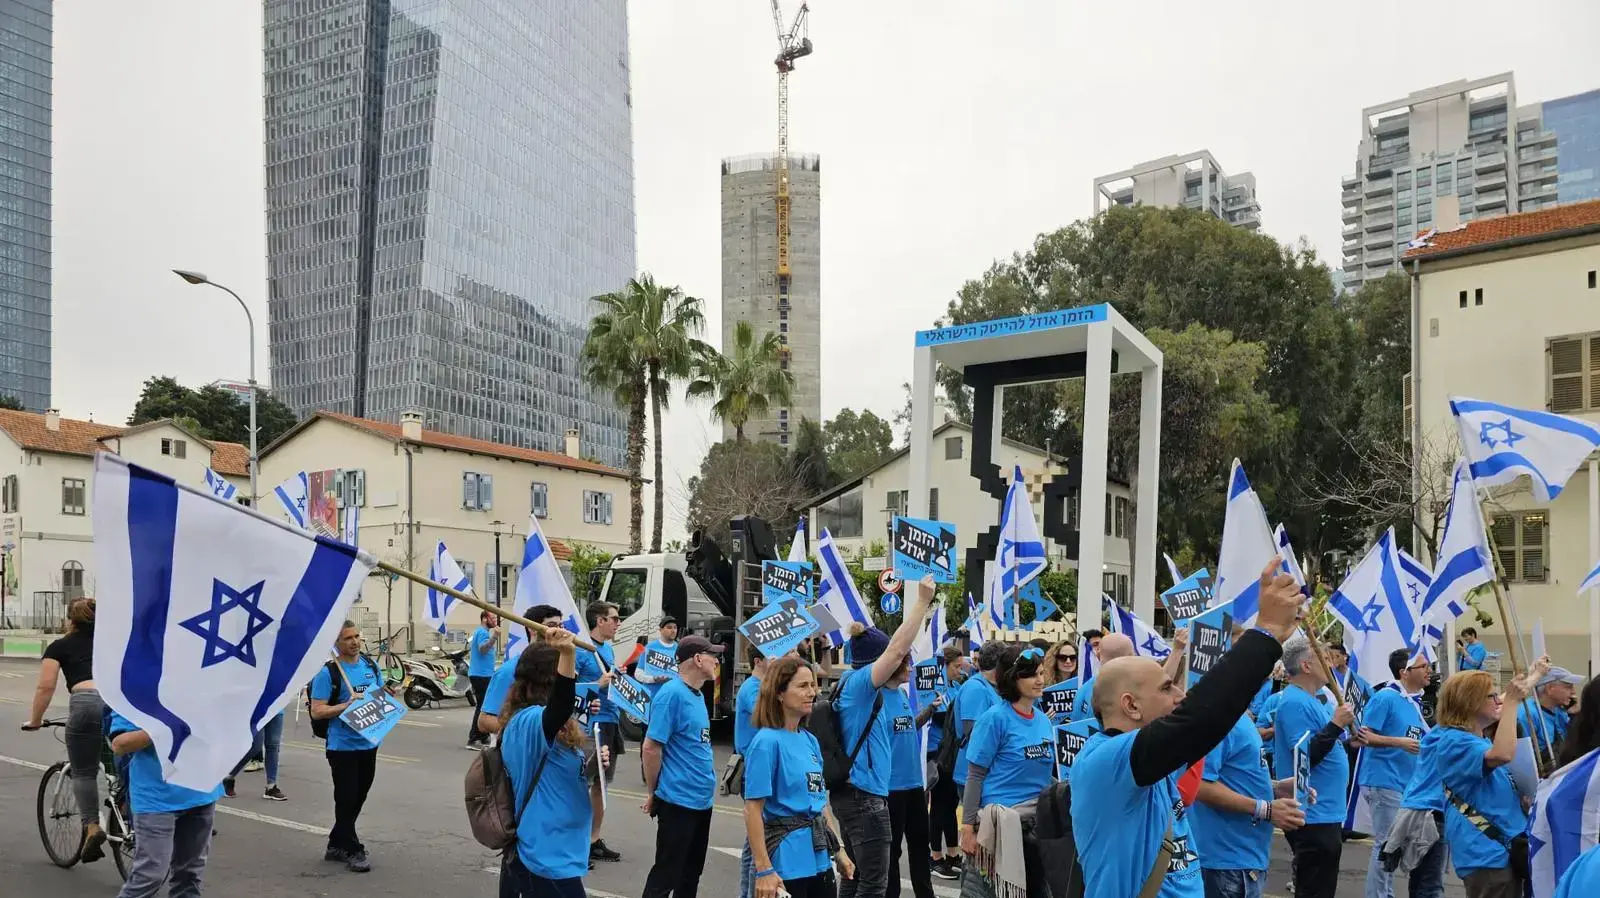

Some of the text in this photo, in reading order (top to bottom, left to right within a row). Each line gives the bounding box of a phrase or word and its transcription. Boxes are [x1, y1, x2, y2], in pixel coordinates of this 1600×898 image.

[924, 309, 1094, 342] הזמן אוזל להייטק הישראלי
[908, 526, 935, 548] הזמן
[900, 535, 926, 561] אוזל
[774, 566, 796, 580] הזמן
[768, 574, 788, 590] אוזל
[1174, 589, 1200, 606] הזמן
[1174, 604, 1198, 618] אוזל
[755, 613, 784, 632] הזמן
[755, 627, 784, 643] אוזל
[1200, 627, 1219, 648] הזמן
[648, 656, 666, 669] אוזל
[654, 652, 671, 662] הזמן
[1193, 645, 1211, 671] אוזל
[921, 666, 936, 678] הזמן
[620, 676, 637, 696] הזמן
[919, 678, 932, 689] אוזל
[1051, 689, 1078, 702] הזמן
[353, 701, 377, 718] הזמן
[1047, 701, 1072, 714] אוזל
[355, 713, 380, 728] אוזל
[1066, 734, 1086, 750] הזמן
[1062, 746, 1076, 764] וזל
